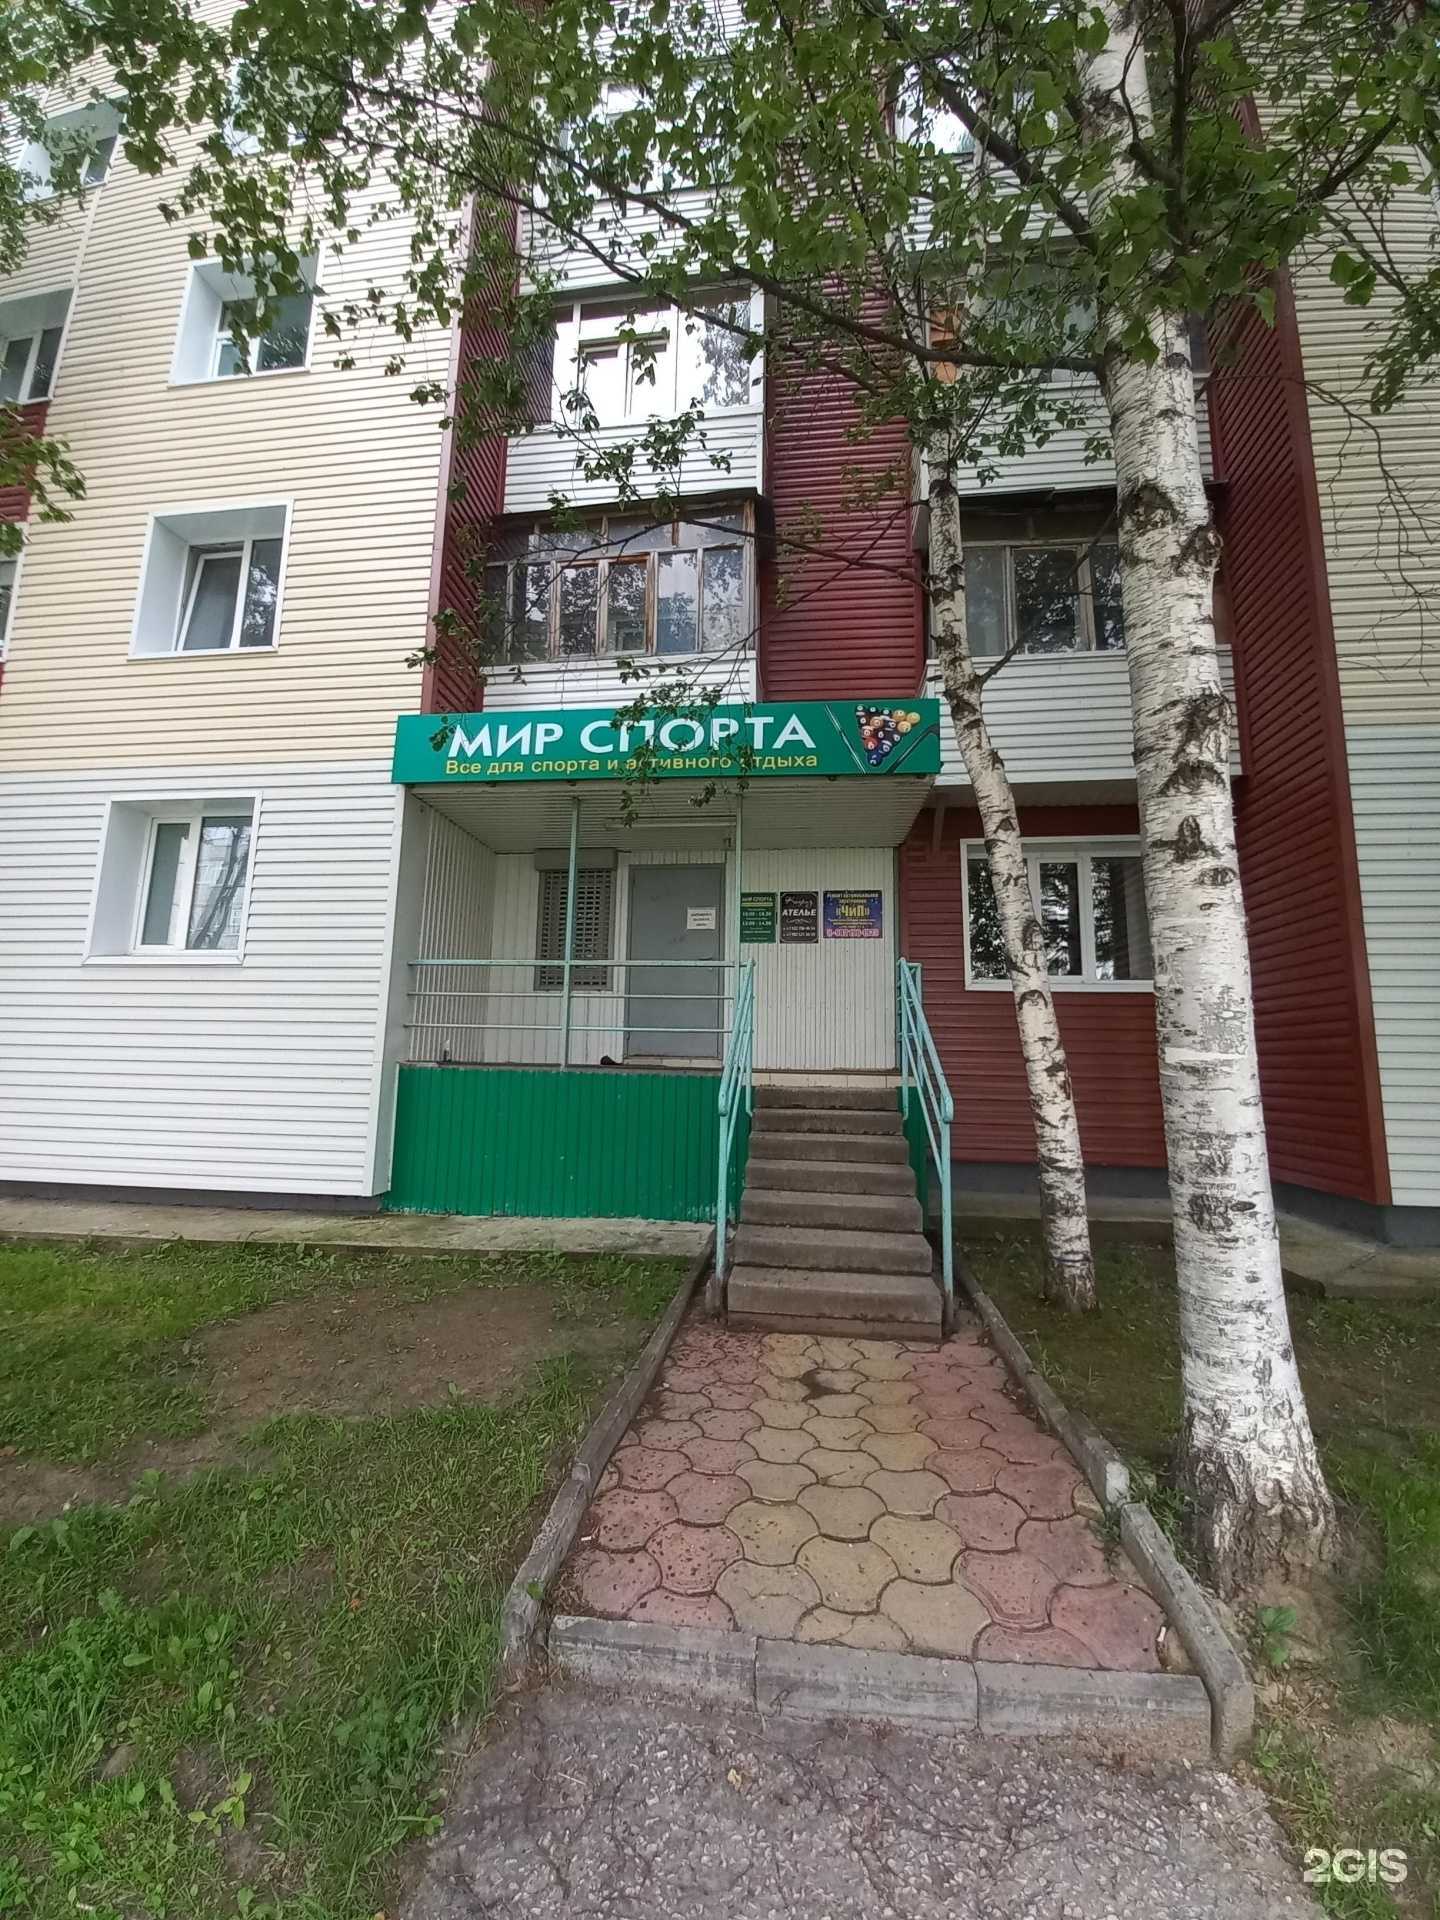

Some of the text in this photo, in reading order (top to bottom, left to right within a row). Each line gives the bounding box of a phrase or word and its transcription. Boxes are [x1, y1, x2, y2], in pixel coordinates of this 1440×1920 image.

[448, 713, 817, 758] МИР СПОРТА
[446, 754, 817, 775] Все для спорта и ативного тдыха
[782, 908, 817, 917] АТЕЛЬЕ
